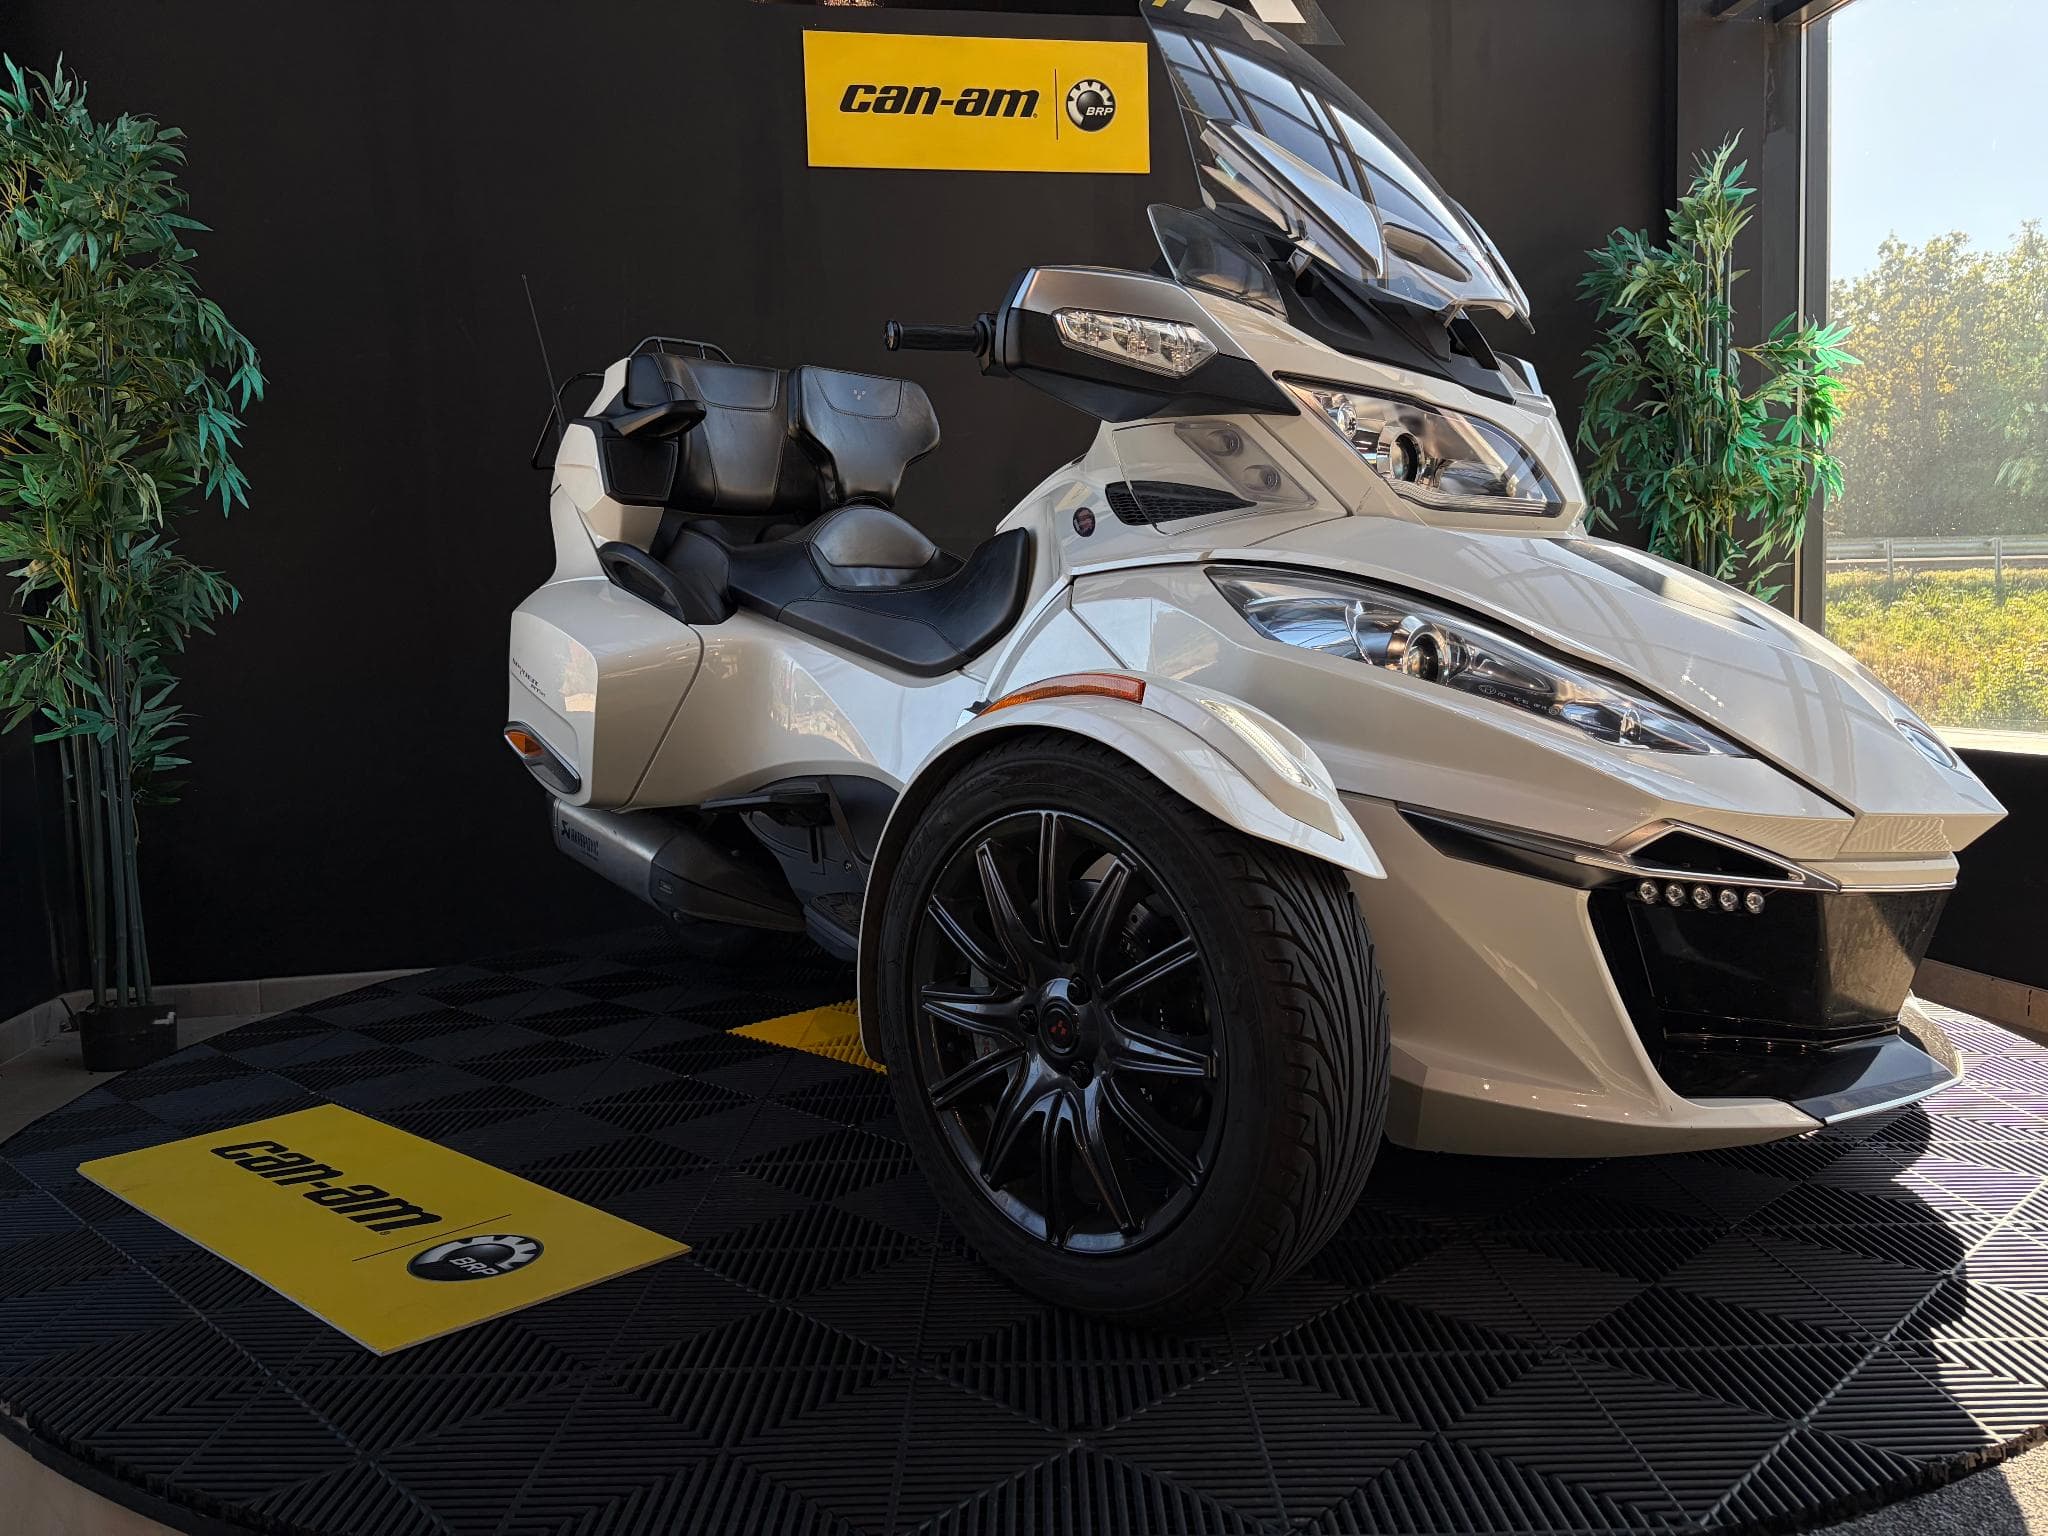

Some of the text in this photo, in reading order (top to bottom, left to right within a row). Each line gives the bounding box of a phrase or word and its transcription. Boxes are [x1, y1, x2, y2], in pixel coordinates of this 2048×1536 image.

[840, 84, 1113, 118] can-am BRP
[210, 1140, 499, 1275] can-am BRP
